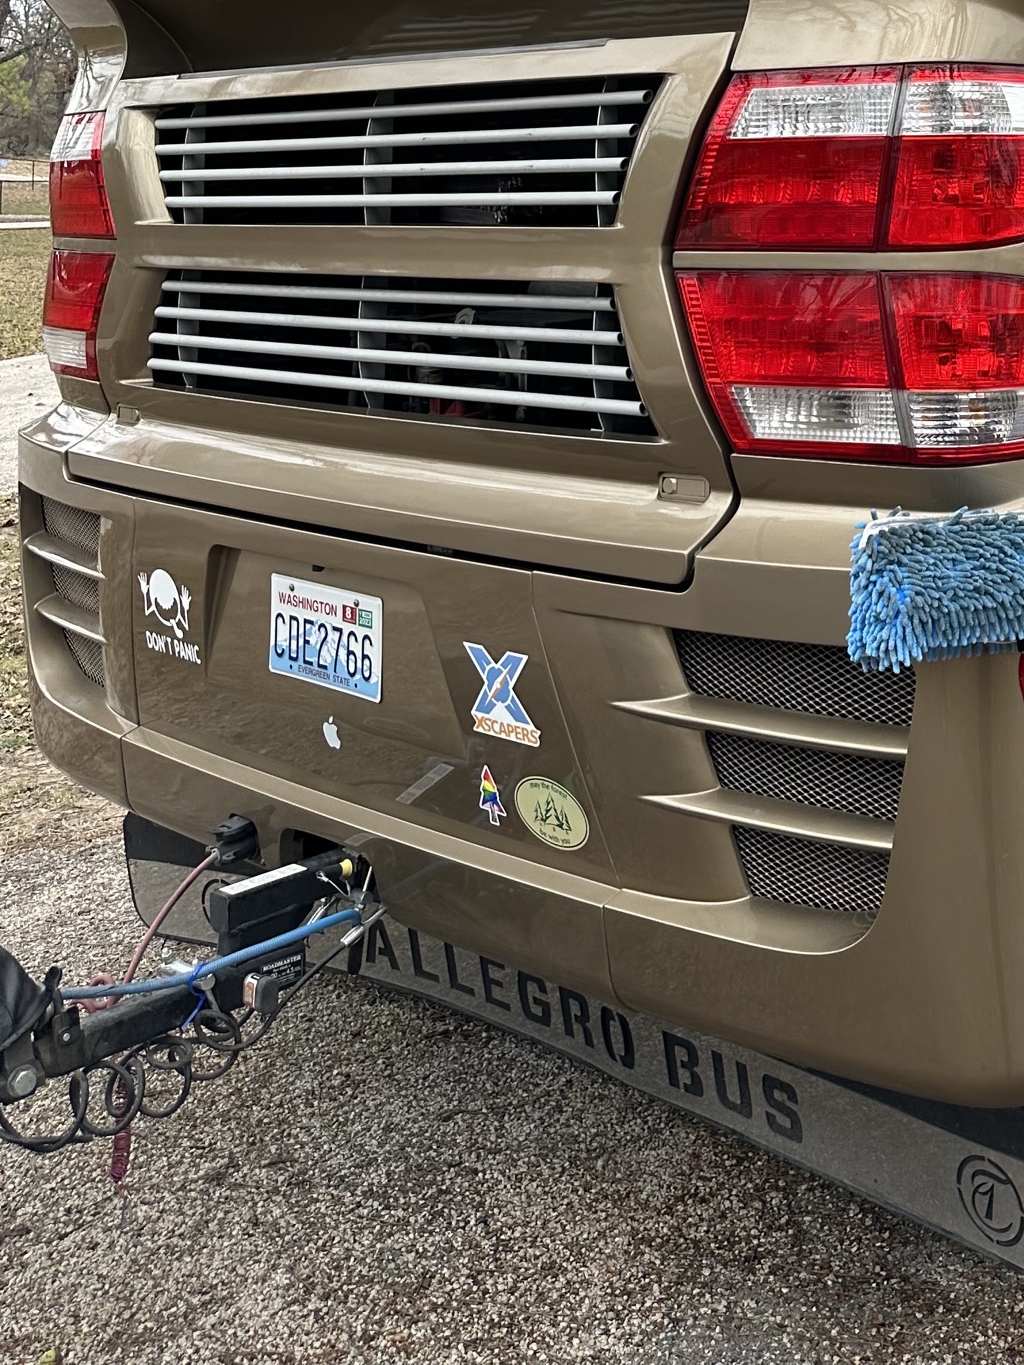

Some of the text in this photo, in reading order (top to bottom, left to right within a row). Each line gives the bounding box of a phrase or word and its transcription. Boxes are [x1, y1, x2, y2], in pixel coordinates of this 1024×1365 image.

[278, 592, 338, 618] WASHINGTON
[145, 630, 201, 664] DON'T PANIC
[274, 612, 373, 682] CDE2766
[298, 665, 350, 687] EVERGREEN STATE
[475, 716, 539, 745] XSCAPERS
[366, 919, 803, 1144] ALLEGRO BUS
